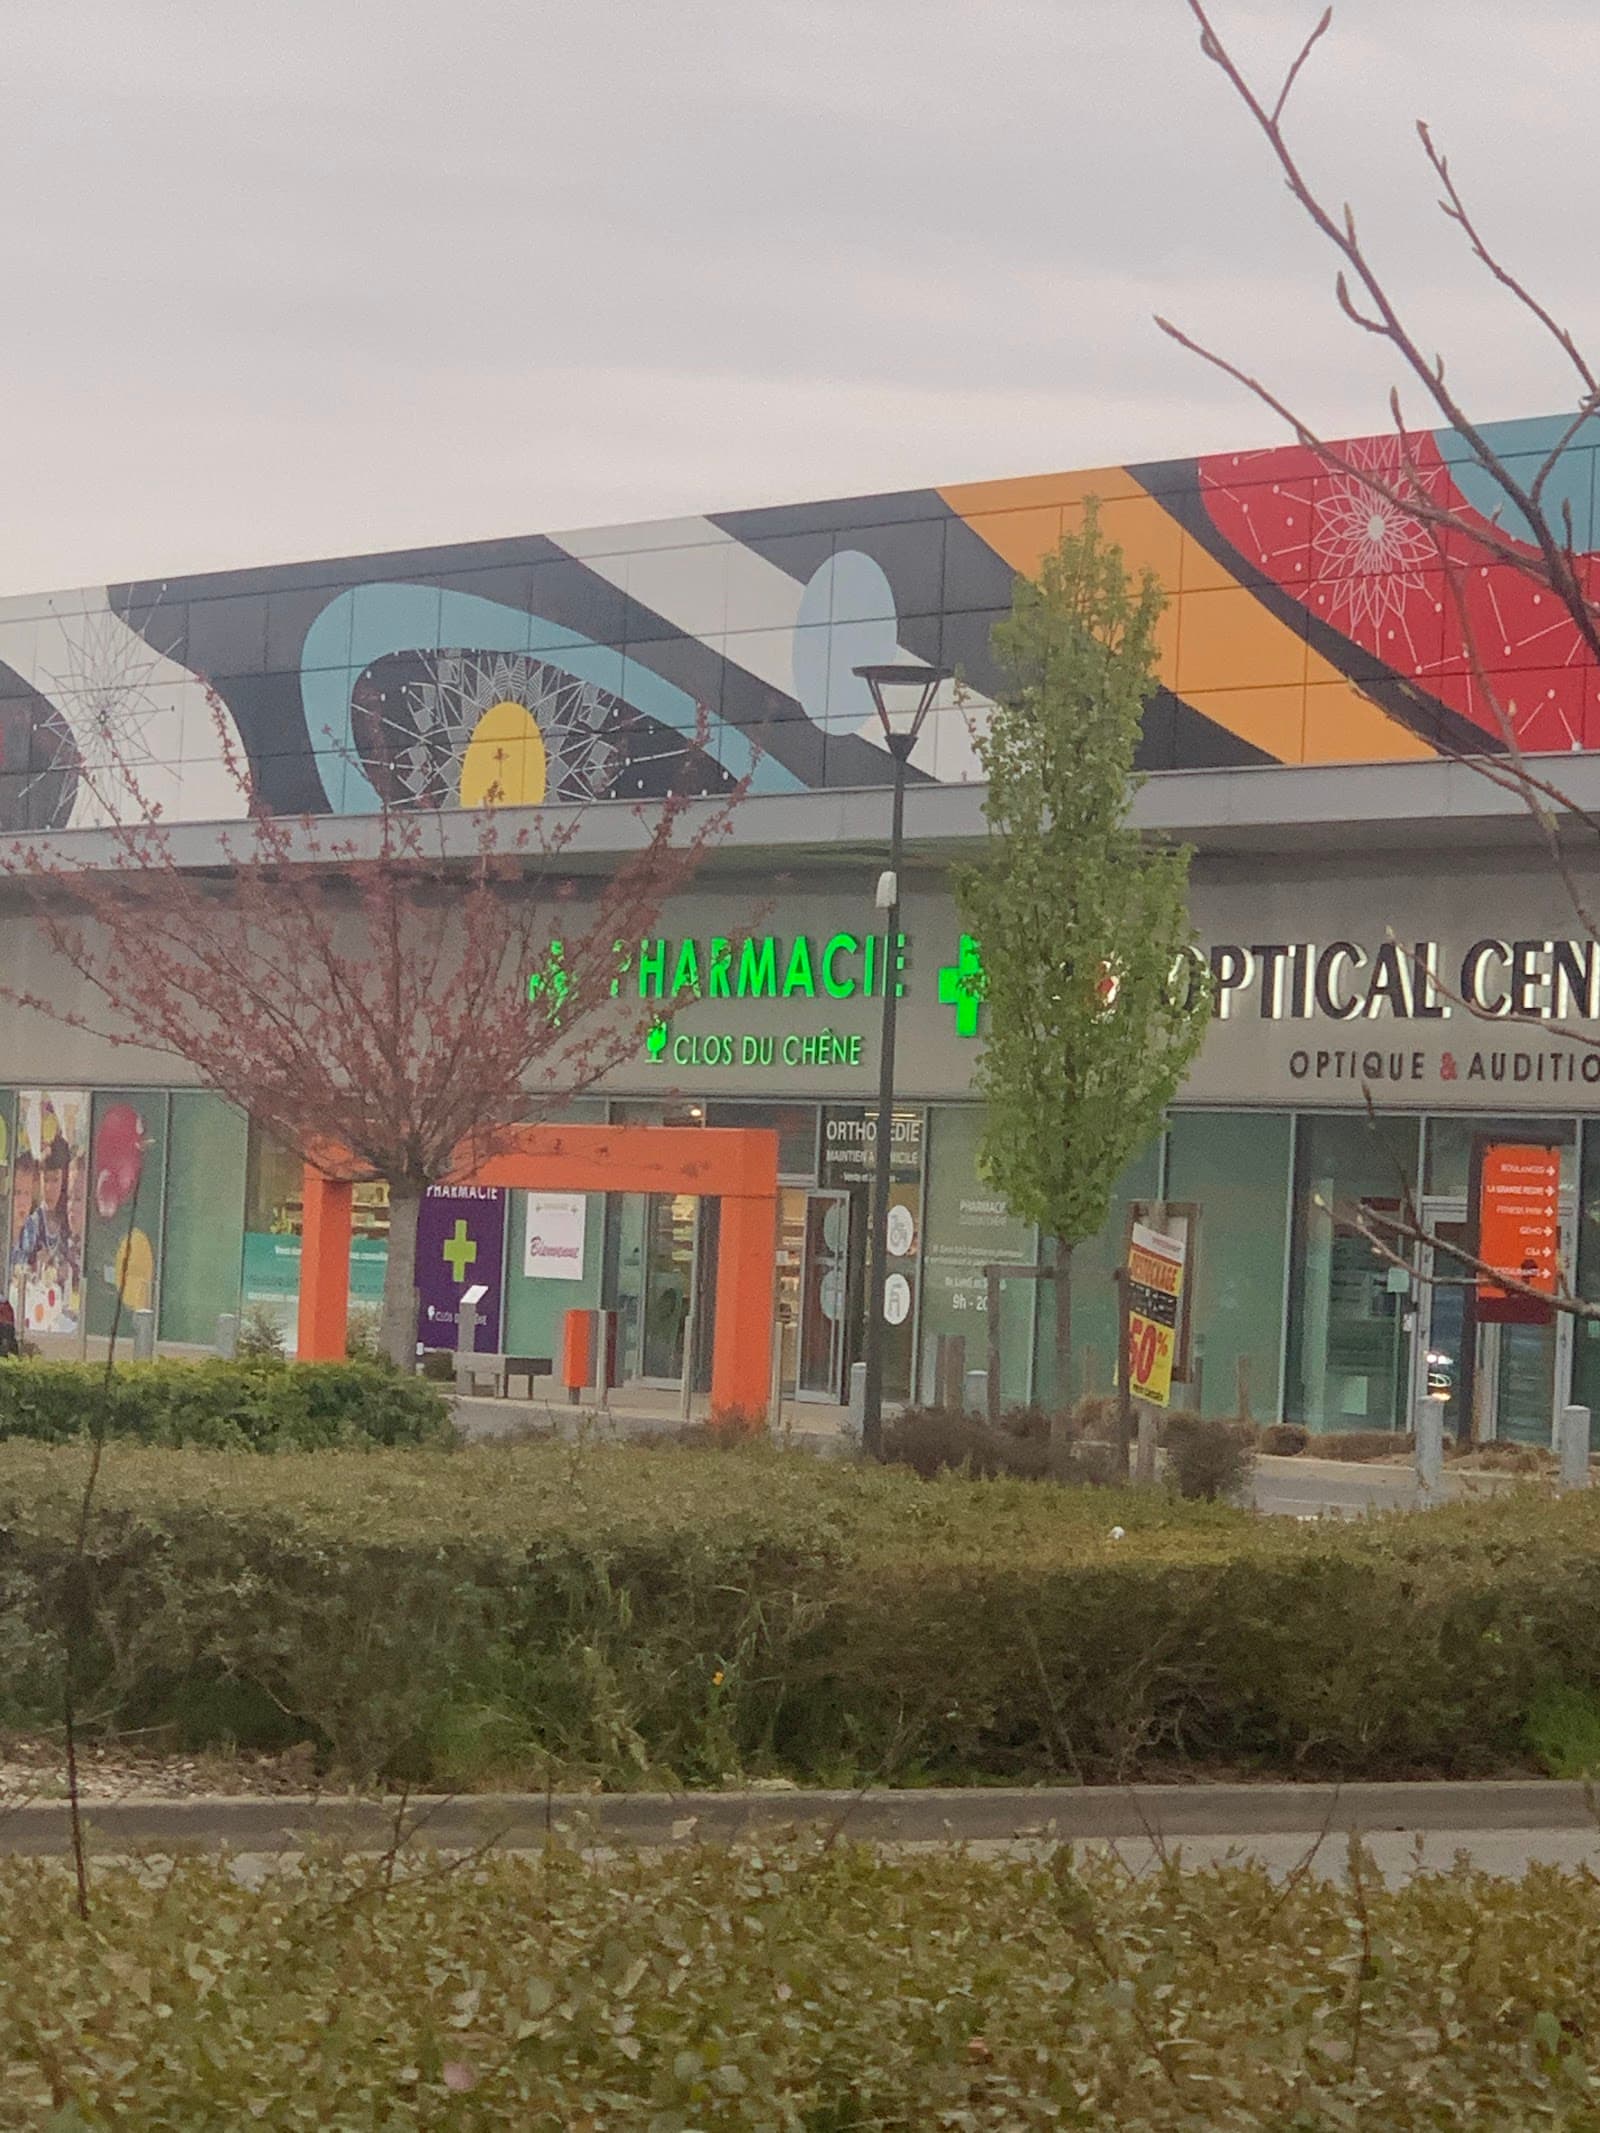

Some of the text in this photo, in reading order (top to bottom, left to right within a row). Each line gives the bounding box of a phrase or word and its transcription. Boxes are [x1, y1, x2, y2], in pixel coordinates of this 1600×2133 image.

[1461, 938, 1600, 1019] CEN
[674, 1027, 862, 1066] CLOS DU CHÊNE
[1289, 1050, 1600, 1082] OPTIQUE & AUDITIO
[826, 1120, 920, 1142] ORTHOEDIE
